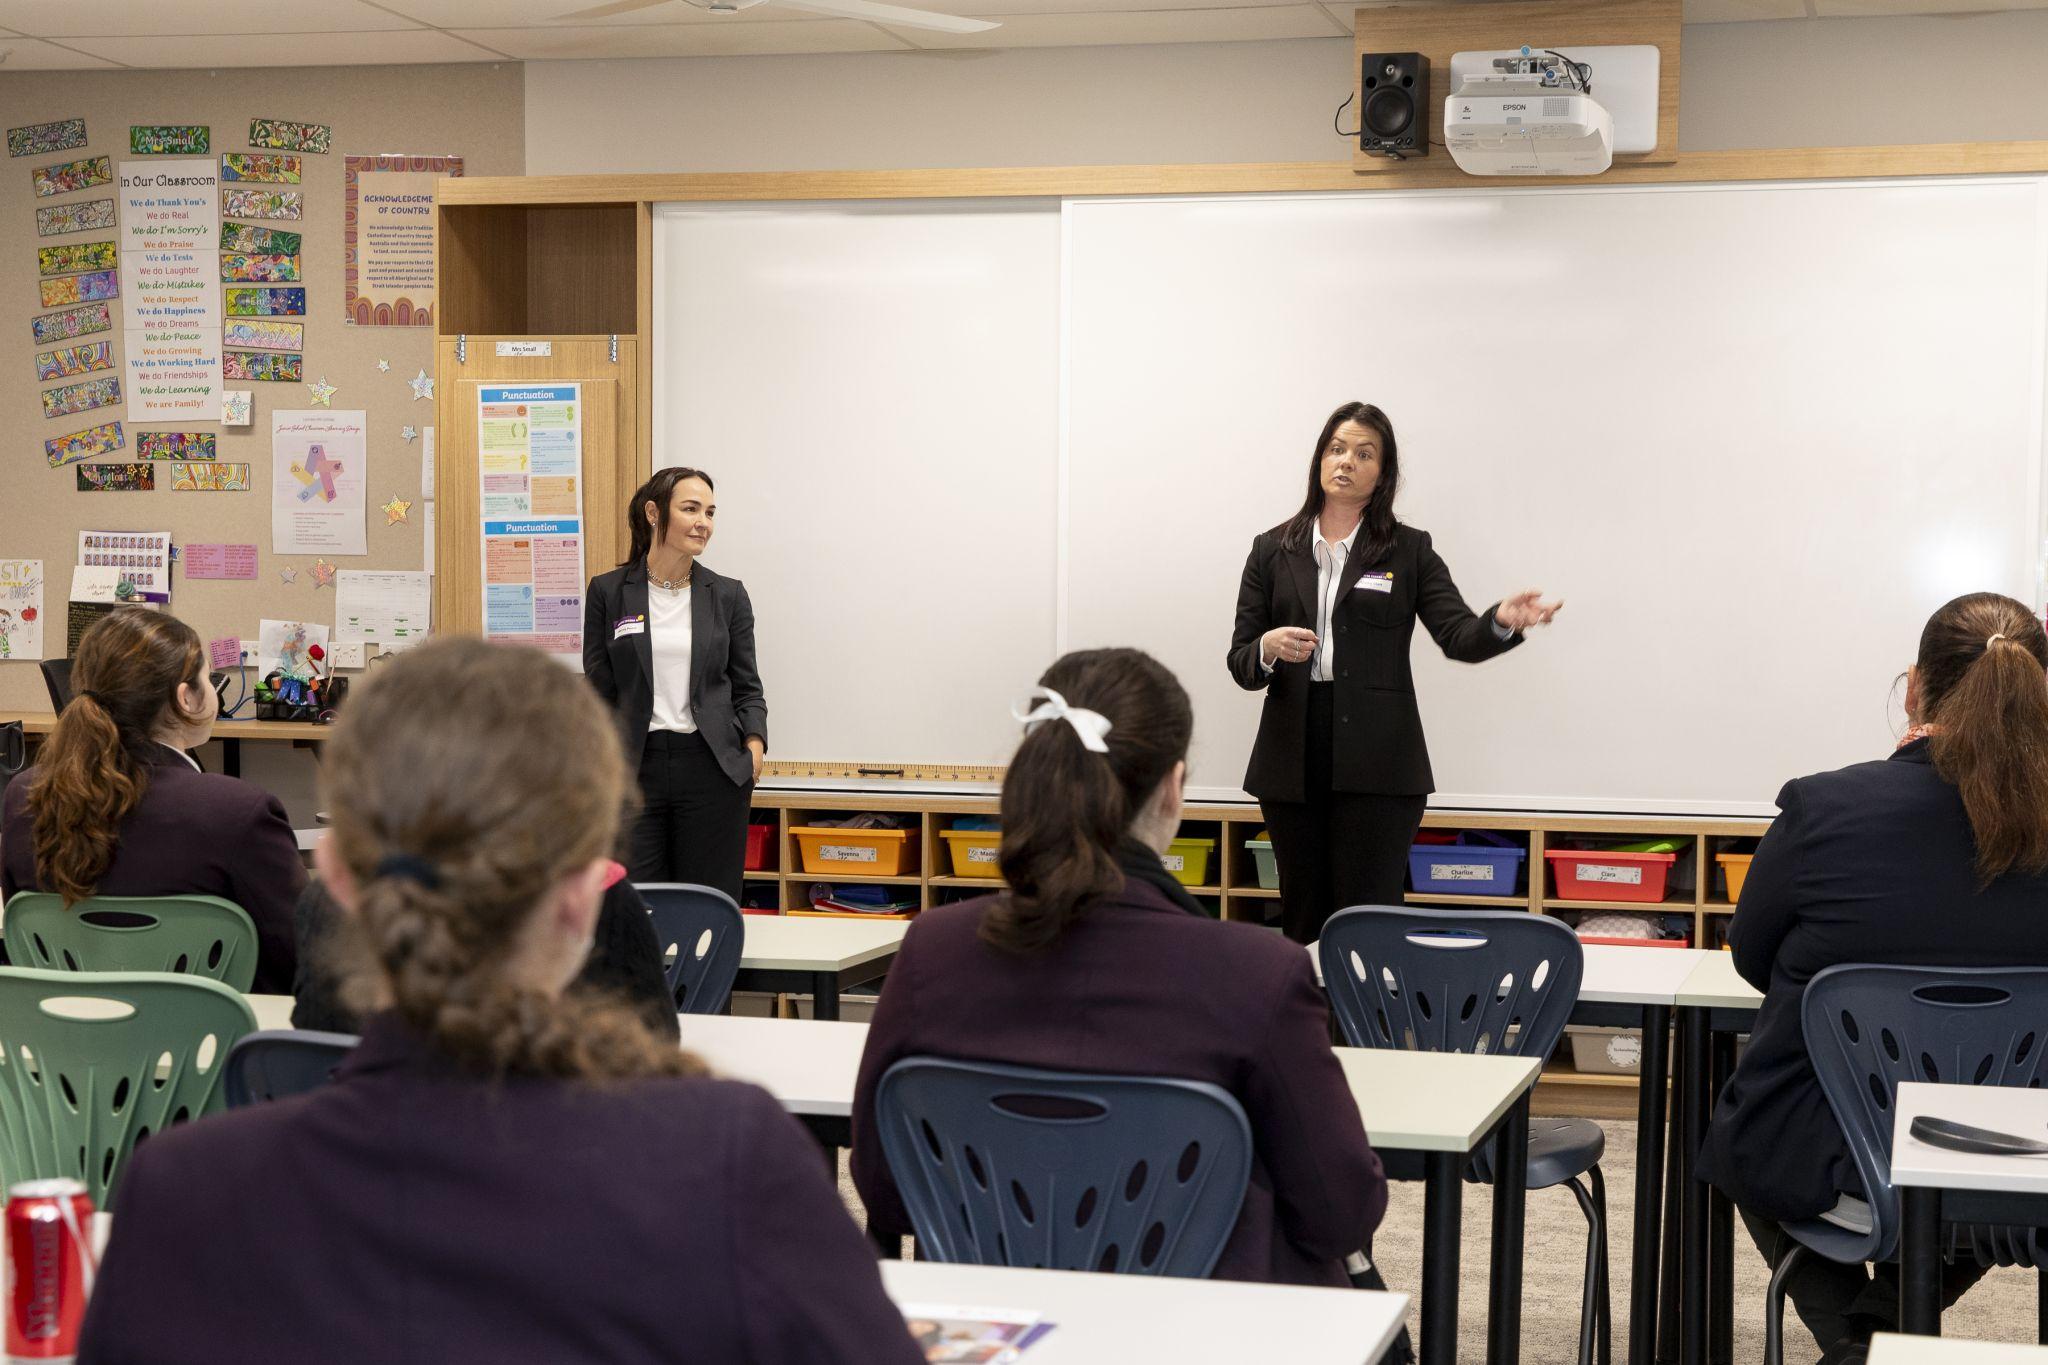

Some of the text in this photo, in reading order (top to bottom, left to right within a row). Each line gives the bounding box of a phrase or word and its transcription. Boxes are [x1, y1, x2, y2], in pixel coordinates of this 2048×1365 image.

[145, 135, 194, 145] Mrs Small
[120, 174, 216, 187] In Our Classroom
[130, 198, 207, 207] We do Thank You's
[364, 195, 433, 203] ACKNOWLEDGEME
[147, 211, 189, 220] We do Real
[131, 225, 209, 236] We do I'm Sorry's
[144, 241, 156, 249] We
[145, 254, 159, 262] We
[161, 253, 171, 261] do
[139, 267, 151, 275] We
[165, 266, 200, 275] Laughter
[137, 280, 206, 290] We do Mistakes
[143, 296, 156, 304] We
[169, 296, 199, 304] Respect
[137, 306, 206, 316] We do Happiness
[169, 320, 199, 328] Dreams
[145, 332, 202, 341] We do Peace
[143, 348, 156, 356] We
[168, 347, 202, 355] Growing
[158, 358, 193, 367] Working
[194, 357, 216, 366] Hard
[139, 372, 151, 380] We
[164, 370, 208, 379] Friendships
[140, 385, 212, 395] We do Learning
[502, 390, 555, 400] Punctuation
[145, 401, 158, 409] We
[174, 400, 204, 409] Family!
[506, 522, 558, 532] Punctuation
